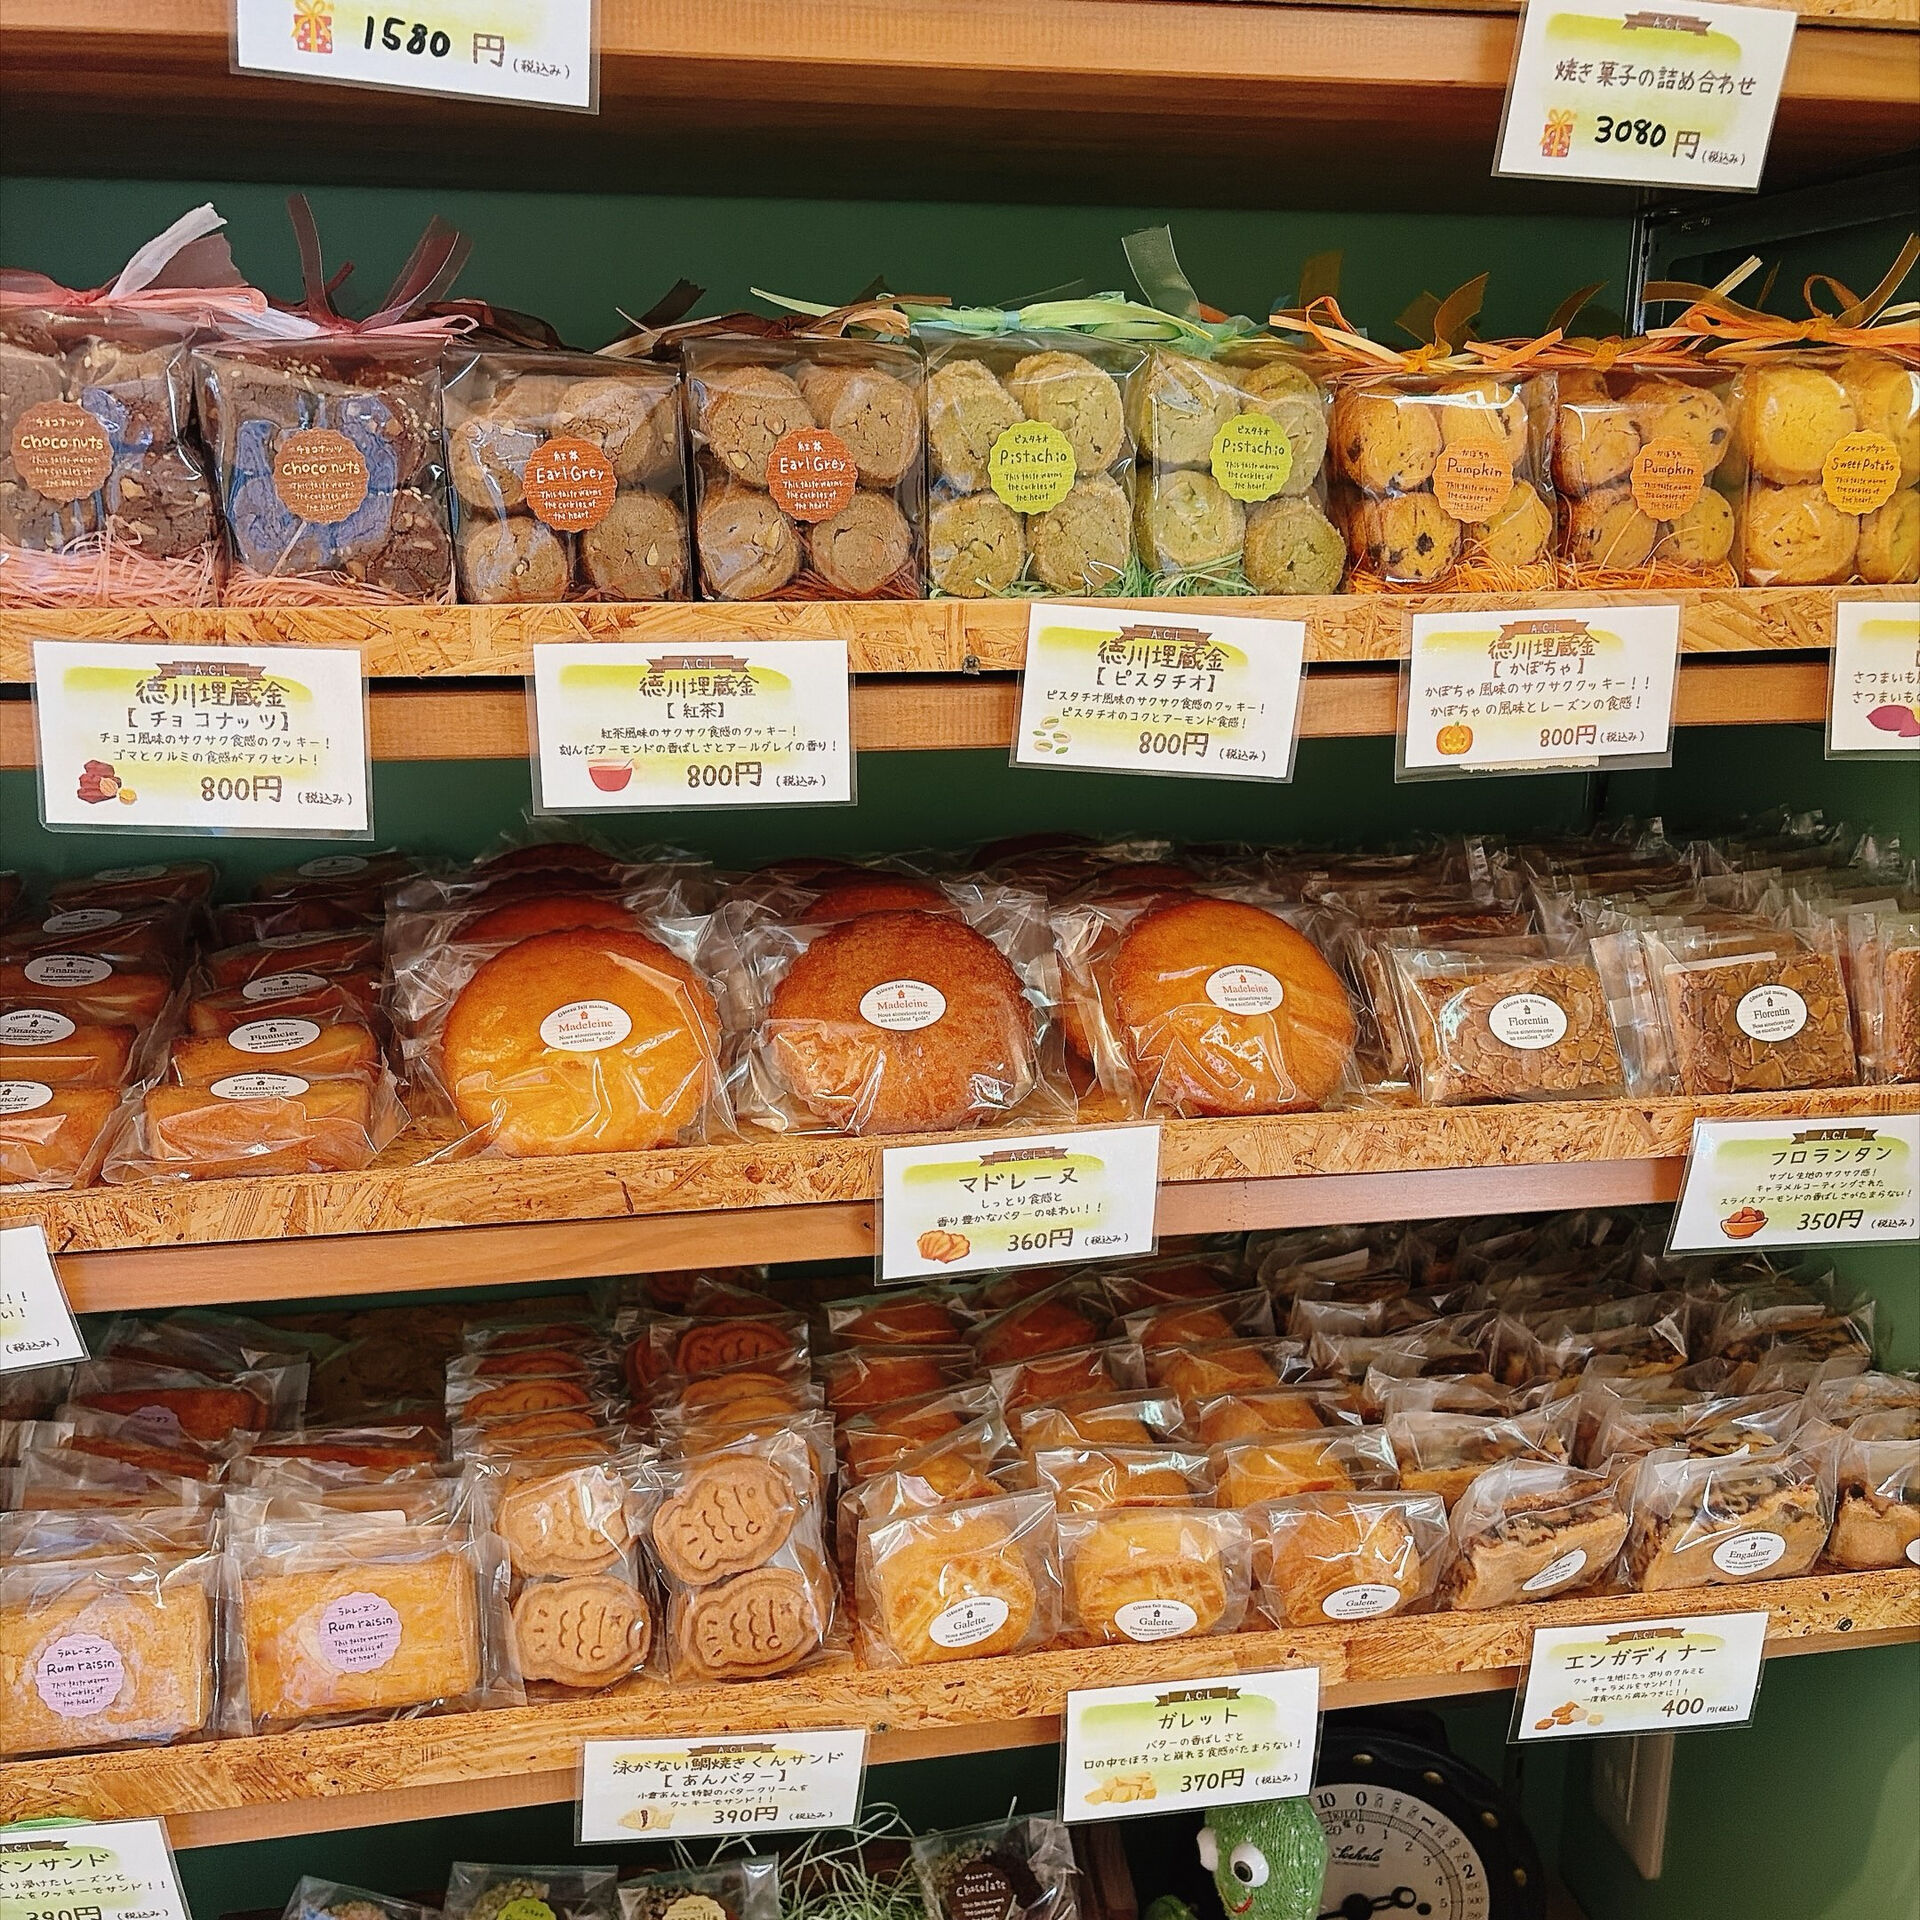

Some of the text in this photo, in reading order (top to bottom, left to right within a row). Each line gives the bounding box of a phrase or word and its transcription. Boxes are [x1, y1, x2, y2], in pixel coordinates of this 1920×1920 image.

[363, 15, 571, 80] 1580 円 (税込み)
[1553, 57, 1758, 97] 焼き菓子の詰め合わせ
[1594, 114, 1746, 167] 3080 円 (税込み)
[1014, 434, 1048, 444] ピスタチオ
[1237, 425, 1270, 435] ピスタチオ
[72, 435, 104, 450] nuts
[1222, 438, 1285, 455] Pistachio
[780, 456, 846, 474] Earl Grey
[1000, 448, 1067, 465] Pistachio
[1831, 456, 1895, 472] Sweet Potato
[331, 460, 360, 475] nuts
[536, 465, 604, 483] Earl Grey
[1447, 457, 1503, 478] Pumpkin
[1643, 458, 1694, 477] Pumpkin
[1097, 639, 1229, 672] 徳川埋蔵金
[1487, 635, 1600, 660] 徳川埋蔵金
[1493, 657, 1585, 679] 【かぼちゃ】
[639, 674, 760, 699] 徳川埋蔵金
[1096, 666, 1216, 692] 【ピスタチオ】
[1425, 676, 1651, 698] かぼちゃ風味のサクサククッキー!!
[135, 679, 290, 709] 徳川埋蔵金
[1047, 690, 1265, 715] ピスタチオ風味のサクサク食感のクッキー!
[667, 701, 726, 719] 【紅茶】
[1430, 696, 1641, 718] かぼちゃの風味とレーズンの食感!
[127, 707, 289, 732] 【チョコナッツ】
[1062, 706, 1247, 729] ピスタチオのコクとアーモンド食感!
[100, 732, 331, 749] チョコ風味のサクサク食感のクッキー!
[601, 725, 798, 740] 紅茶風味のサクサク食感のクッキー!
[1539, 724, 1645, 748] 800円 (税込み)
[1139, 731, 1266, 762] 800円 (税込み)
[112, 749, 319, 766] ゴマとクルミの食感がアクセント!
[687, 761, 827, 789] 800円 (税込み)
[200, 774, 353, 806] 800円 (税込み)
[1223, 984, 1269, 994] Madeleine
[877, 999, 928, 1010] Madeleine
[1753, 1006, 1791, 1020] Florentin
[6, 1026, 54, 1034] Financier
[558, 1019, 613, 1033] Madeleine
[1508, 1015, 1549, 1027] Florentin
[1771, 1146, 1892, 1166] フロランタン
[958, 1167, 1079, 1193] マドレーヌ
[1769, 1168, 1877, 1181] サブレ生地のサクサク感!
[1756, 1179, 1885, 1193] キャラメルコーティングされた
[980, 1192, 1063, 1209] しっとり食感と
[937, 1202, 1102, 1227] 香り豊かなバターの味わい!!
[1796, 1208, 1915, 1231] 350円 (税込み)
[1007, 1227, 1129, 1252] 360円 (税込み)
[6, 1337, 60, 1354] (税込み)
[337, 1603, 380, 1616] ラムレーズン
[1346, 1599, 1378, 1607] Galette
[328, 1617, 393, 1634] Rum raisin
[953, 1616, 986, 1630] Galette
[1139, 1618, 1174, 1626] Galette
[57, 1646, 102, 1658] ラムレーズン
[1564, 1644, 1717, 1670] エンガディナー
[47, 1660, 115, 1676] Rum raisin
[1661, 1697, 1704, 1718] 400
[1158, 1707, 1239, 1730] ガレット
[1146, 1732, 1245, 1750] バターの香ばしさと
[1084, 1738, 1302, 1770] 口の中でほろっと崩れる食感がたまらない!
[612, 1752, 844, 1776] 泳がない鯛焼きくんサンド
[664, 1769, 786, 1788] 【あんバター】
[1180, 1767, 1300, 1793] 370円 (税込み)
[1317, 1792, 1336, 1808] 10
[1356, 1791, 1367, 1806] 0
[713, 1806, 778, 1825] 390円
[1356, 1823, 1365, 1835] 0
[1383, 1829, 1388, 1840] 1
[1463, 1864, 1476, 1879] 2
